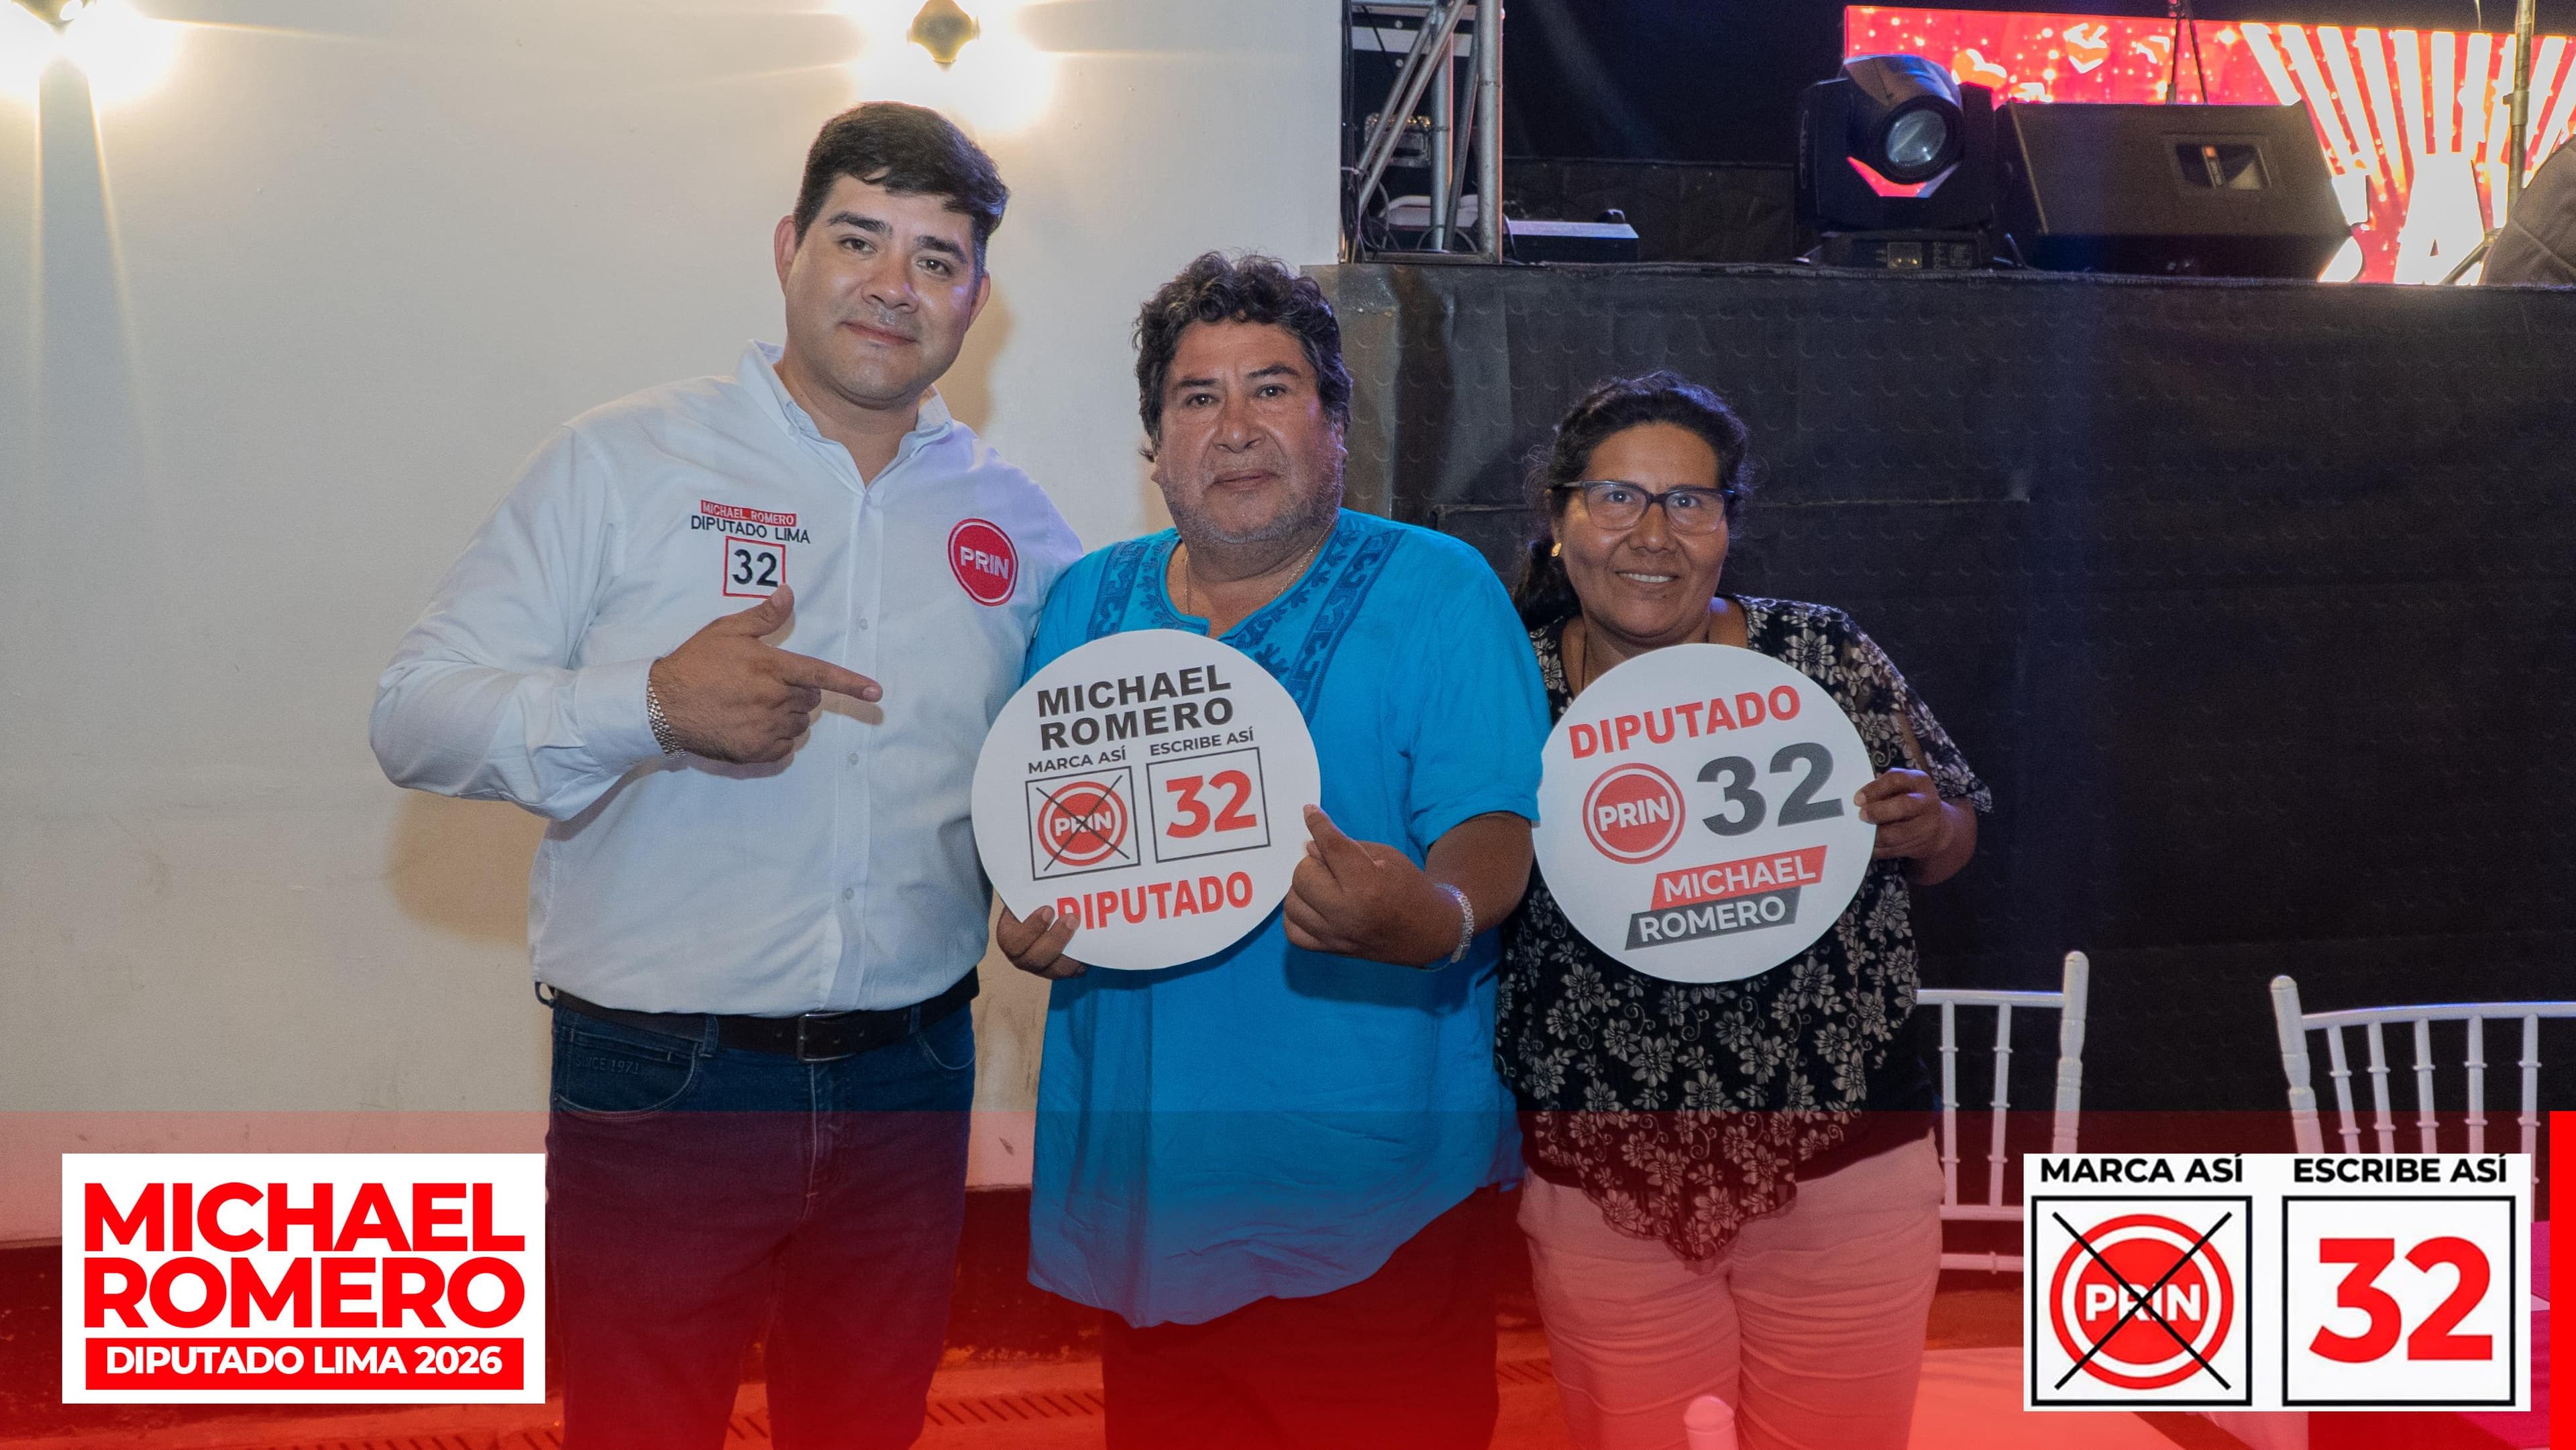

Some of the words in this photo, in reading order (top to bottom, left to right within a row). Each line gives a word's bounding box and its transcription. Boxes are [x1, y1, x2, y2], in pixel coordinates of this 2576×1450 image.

[691, 515, 767, 538] DIPUTADO
[775, 527, 810, 544] LIMA
[702, 501, 746, 519] MICHAEL
[751, 510, 795, 525] ROMERO
[731, 548, 778, 587] 32
[959, 546, 1009, 579] PRIN
[1037, 665, 1232, 718] MICHAEL
[1040, 697, 1234, 750] ROMERO
[1150, 735, 1222, 757] ESCRIBE
[1226, 726, 1254, 744] ASÍ
[1568, 685, 1801, 759] DIPUTADO
[1028, 755, 1093, 774] MARCA
[1097, 745, 1127, 765] ASÍ
[1166, 769, 1257, 839] 32
[1697, 742, 1845, 836] 32
[1054, 811, 1113, 837] PRIN
[1598, 795, 1670, 832] PRIN
[1056, 871, 1253, 930] DIPUTADO
[1662, 855, 1816, 903] MICHAEL
[1639, 896, 1786, 943] ROMERO
